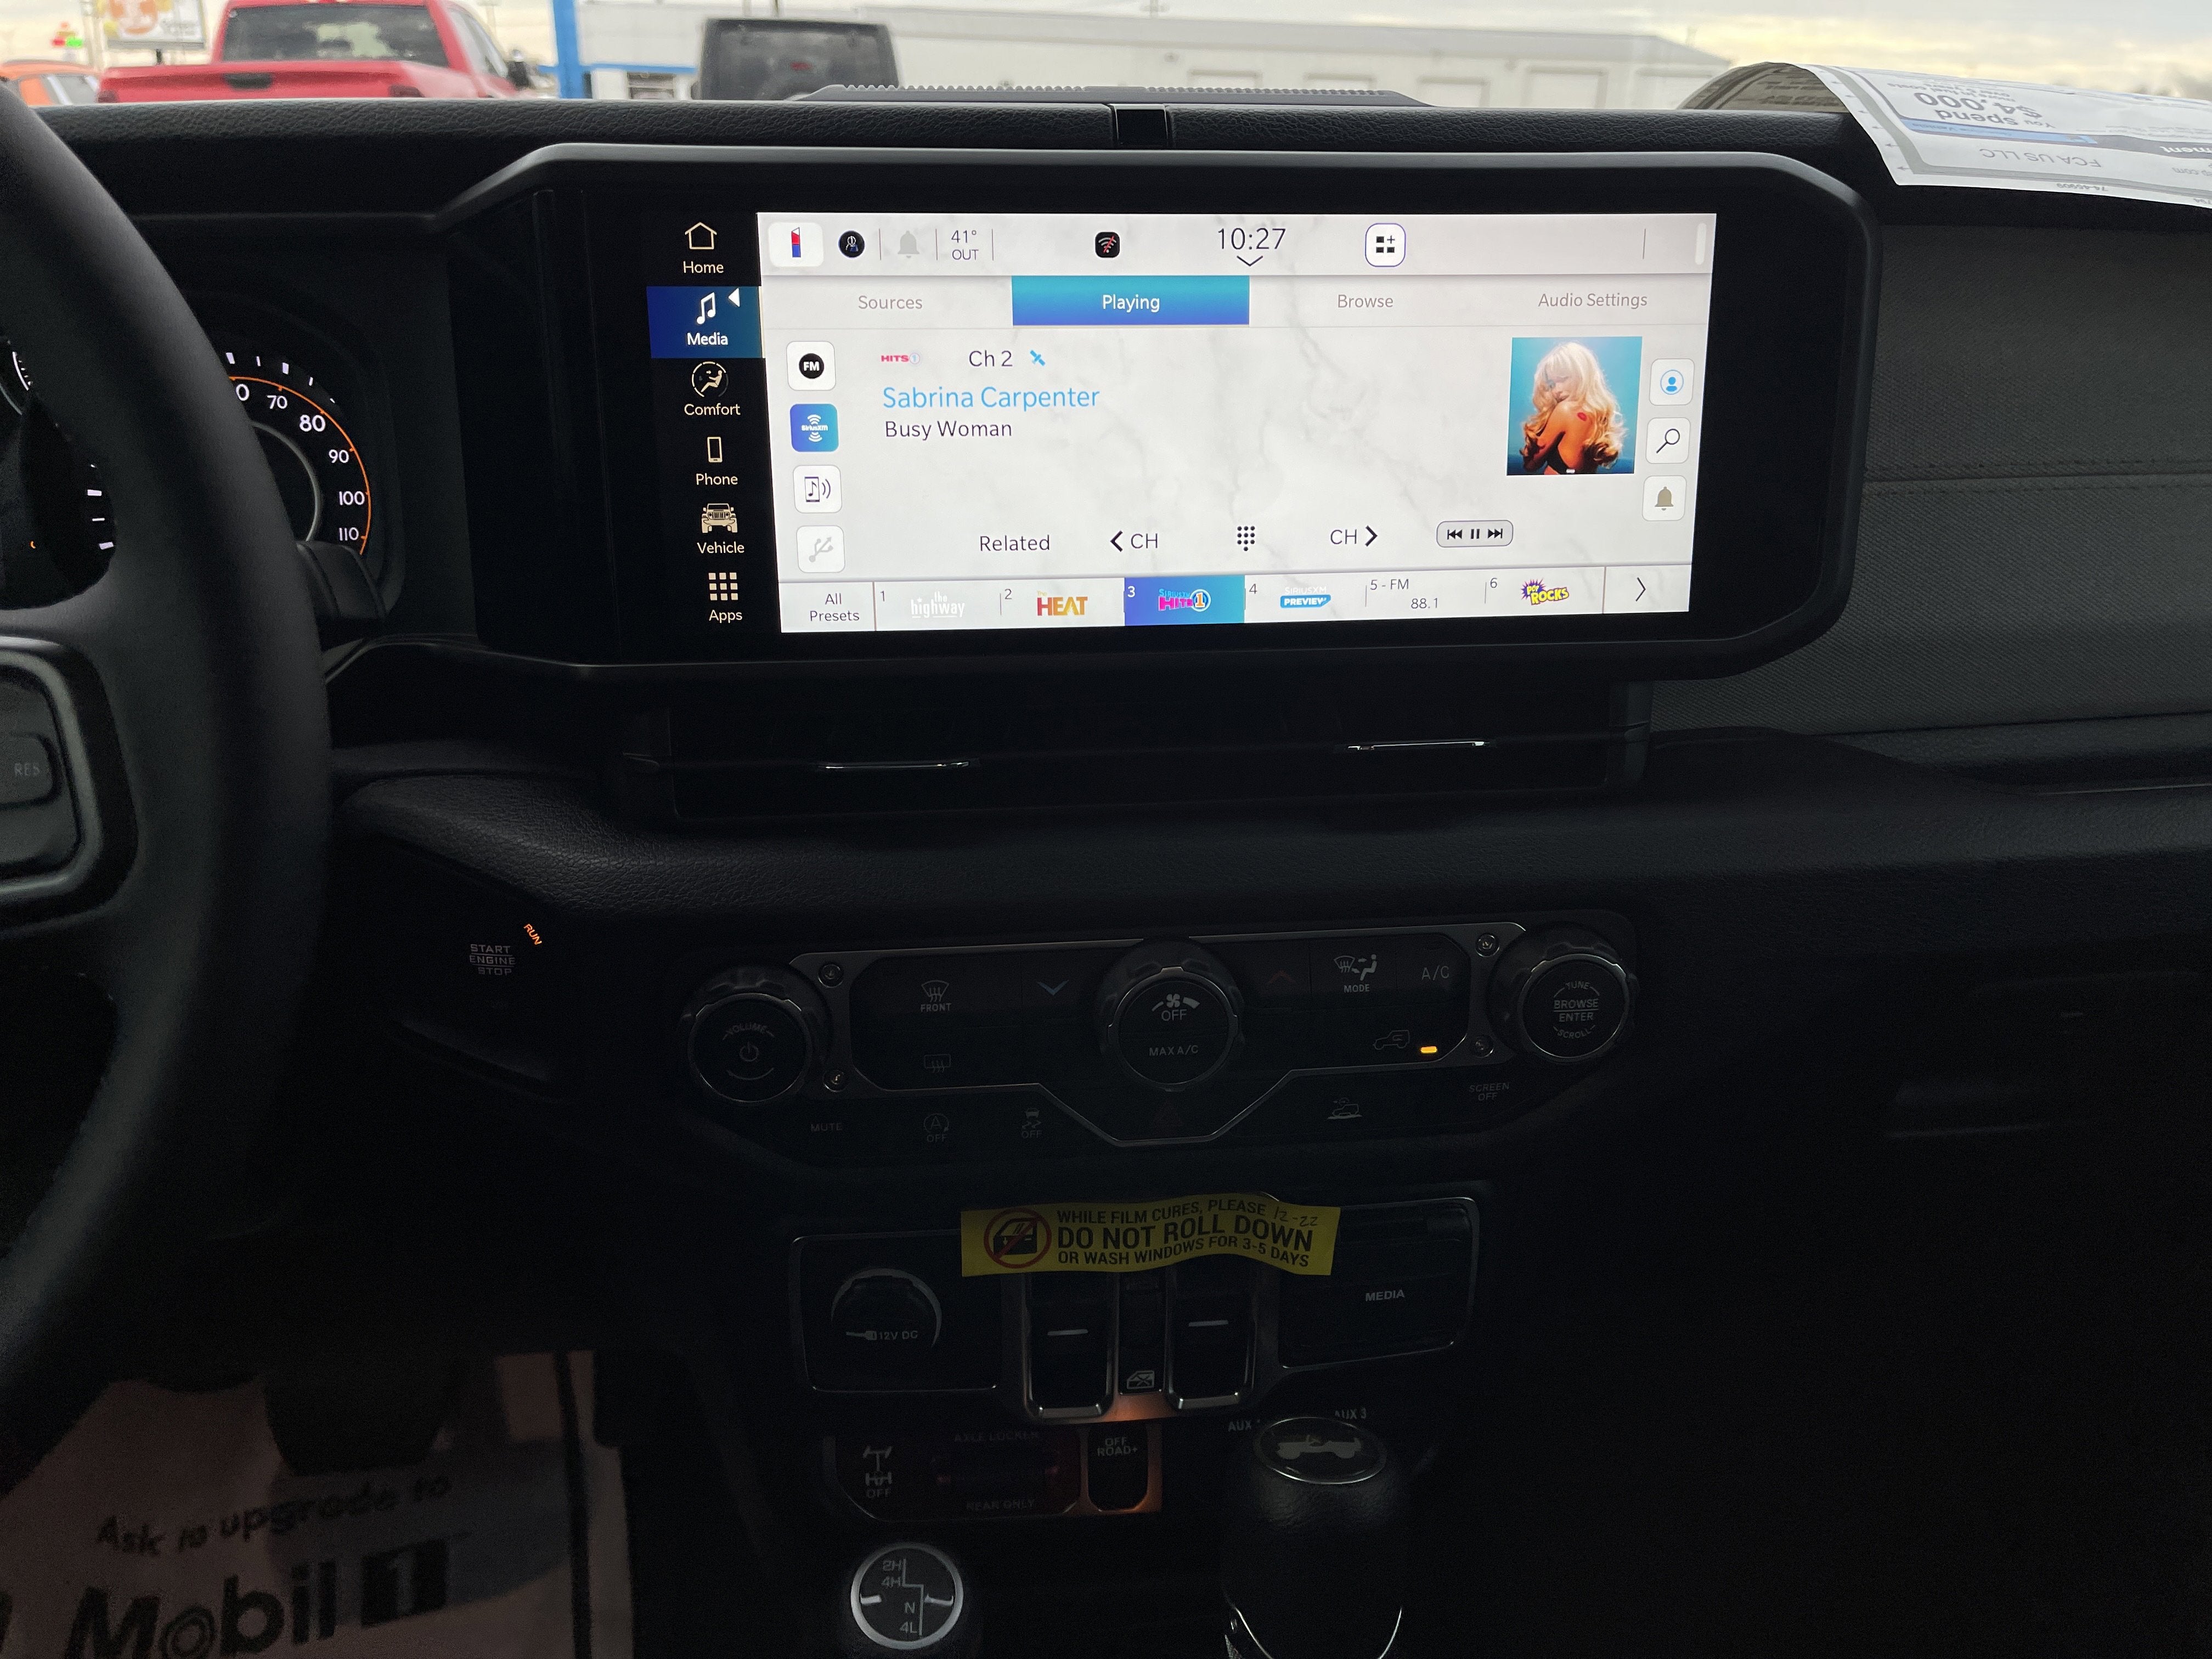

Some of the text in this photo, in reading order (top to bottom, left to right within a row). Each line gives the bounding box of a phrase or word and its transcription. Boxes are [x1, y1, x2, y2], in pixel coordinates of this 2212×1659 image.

[1934, 109, 2056, 129] You spend
[1979, 149, 2102, 168] FCA US LLC
[951, 230, 977, 244] 41°
[1217, 228, 1286, 251] 10:27
[952, 249, 979, 261] OUT
[683, 261, 724, 274] Home
[858, 295, 923, 311] Sources
[1102, 294, 1160, 313] Playing
[1338, 294, 1393, 308] Browse
[1538, 292, 1647, 309] Audio Settings
[687, 332, 729, 346] Media
[881, 354, 909, 363] HITS
[968, 351, 1012, 368] Ch 2
[803, 360, 820, 372] FM
[235, 384, 250, 400] 0
[267, 394, 288, 409] 70
[883, 386, 1099, 411] Sabrina Carpenter
[684, 403, 741, 416] Comfort
[299, 415, 326, 432] 80
[885, 421, 1012, 439] Busy Woman
[329, 449, 349, 464] 90
[696, 473, 738, 486] Phone
[338, 491, 365, 505] 100
[338, 527, 359, 541] 110
[1330, 529, 1357, 545] CH
[980, 535, 1049, 551] Related
[1131, 533, 1158, 549] CH
[697, 542, 744, 554] Vehicle
[1249, 583, 1257, 594] 4
[1370, 579, 1378, 590] 5
[1391, 579, 1409, 590] FM
[1490, 578, 1497, 588] 6
[880, 591, 885, 601] 1
[934, 591, 947, 602] the
[1005, 589, 1012, 600] 2
[1127, 585, 1136, 597] 3
[1531, 587, 1569, 605] ROCKS
[825, 594, 842, 605] All
[1159, 592, 1205, 611] HITS 1
[1411, 597, 1438, 609] 88.1
[911, 599, 965, 618] highway
[1037, 596, 1088, 616] HEAT
[709, 610, 743, 623] Apps
[810, 610, 860, 622] Presets
[523, 923, 543, 946] RUN
[470, 944, 511, 954] START
[470, 955, 516, 966] ENGINE
[478, 967, 512, 976] STOP
[1421, 965, 1449, 981] A/C
[1344, 984, 1370, 994] MODE
[1565, 981, 1590, 990] TUNE
[921, 1002, 952, 1013] FRONT
[1554, 998, 1599, 1009] BROWSE
[1161, 1009, 1187, 1022] OFF
[1559, 1012, 1594, 1022] ENTER
[727, 1022, 768, 1035] VOLUME
[1556, 1027, 1591, 1039] SCROLL
[1149, 1045, 1199, 1056] MAX A/C
[1469, 1082, 1509, 1092] SCREEN
[1478, 1092, 1497, 1101] OFF
[810, 1122, 843, 1132] MUTE
[926, 1133, 947, 1143] OFF
[1021, 1129, 1042, 1139] OFF
[1058, 1199, 1266, 1224] WHILE FILM CURES, PLEASE
[1057, 1214, 1313, 1252] DO NOT ROLL DOWN
[1058, 1235, 1309, 1267] OR WASH WINDOWS FOR 3-5 DAYS
[1365, 1289, 1404, 1302] MEDIA
[879, 1330, 918, 1340] 12V DC
[1335, 1407, 1367, 1419] AUX 3
[1228, 1421, 1252, 1432] AUX
[1105, 1437, 1127, 1446] OFF
[1097, 1446, 1138, 1456] ROAD+
[866, 1488, 891, 1499] OFF
[97, 1515, 165, 1555] Ask
[220, 1481, 399, 1542] upgrade
[882, 1560, 902, 1572] 2H
[882, 1576, 901, 1588] 4H
[66, 1562, 336, 1659] Mobil
[904, 1602, 915, 1614] N
[900, 1622, 917, 1634] 4L
